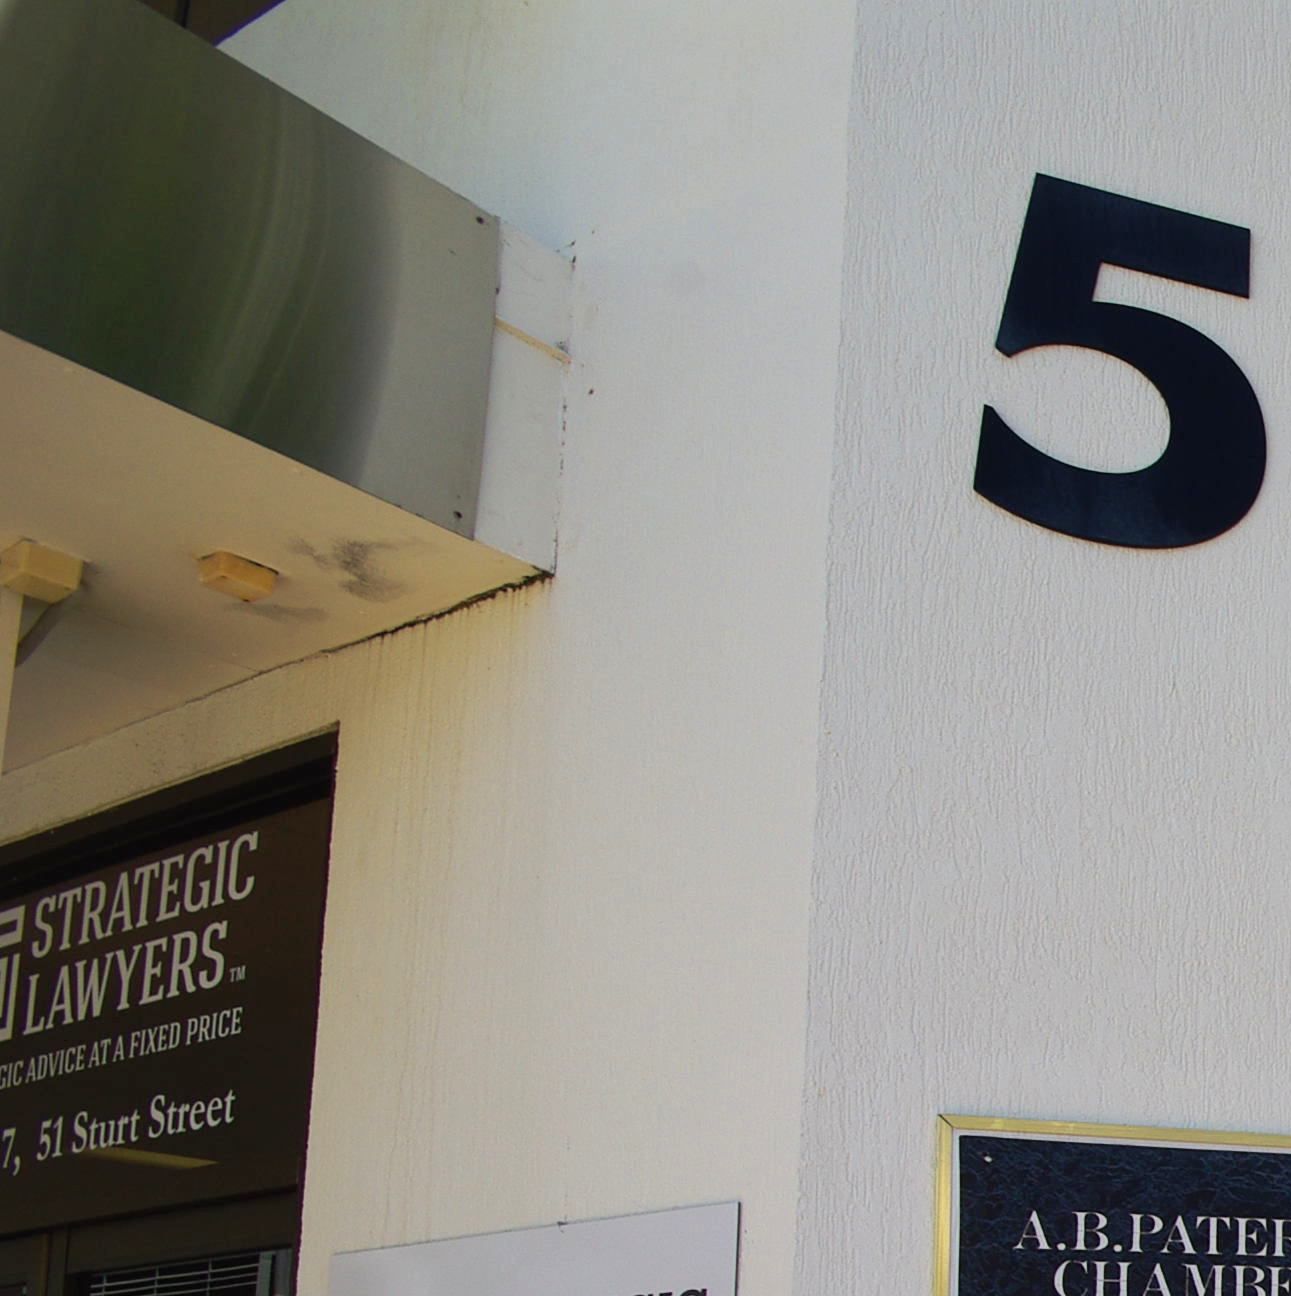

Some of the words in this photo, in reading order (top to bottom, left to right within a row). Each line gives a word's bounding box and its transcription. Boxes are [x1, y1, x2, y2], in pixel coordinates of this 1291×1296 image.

[32, 831, 260, 959] STRATEGIC
[23, 920, 229, 1036] LAWYERS
[25, 1044, 87, 1084] ADVICE
[88, 1037, 112, 1069] AT
[112, 1035, 125, 1063] A
[128, 1021, 181, 1059] FIXED
[185, 1006, 243, 1046] PRICE
[1, 1127, 21, 1176] 7,
[36, 1115, 64, 1162] 51
[71, 1108, 140, 1154] Sturt
[148, 1088, 237, 1139] Street
